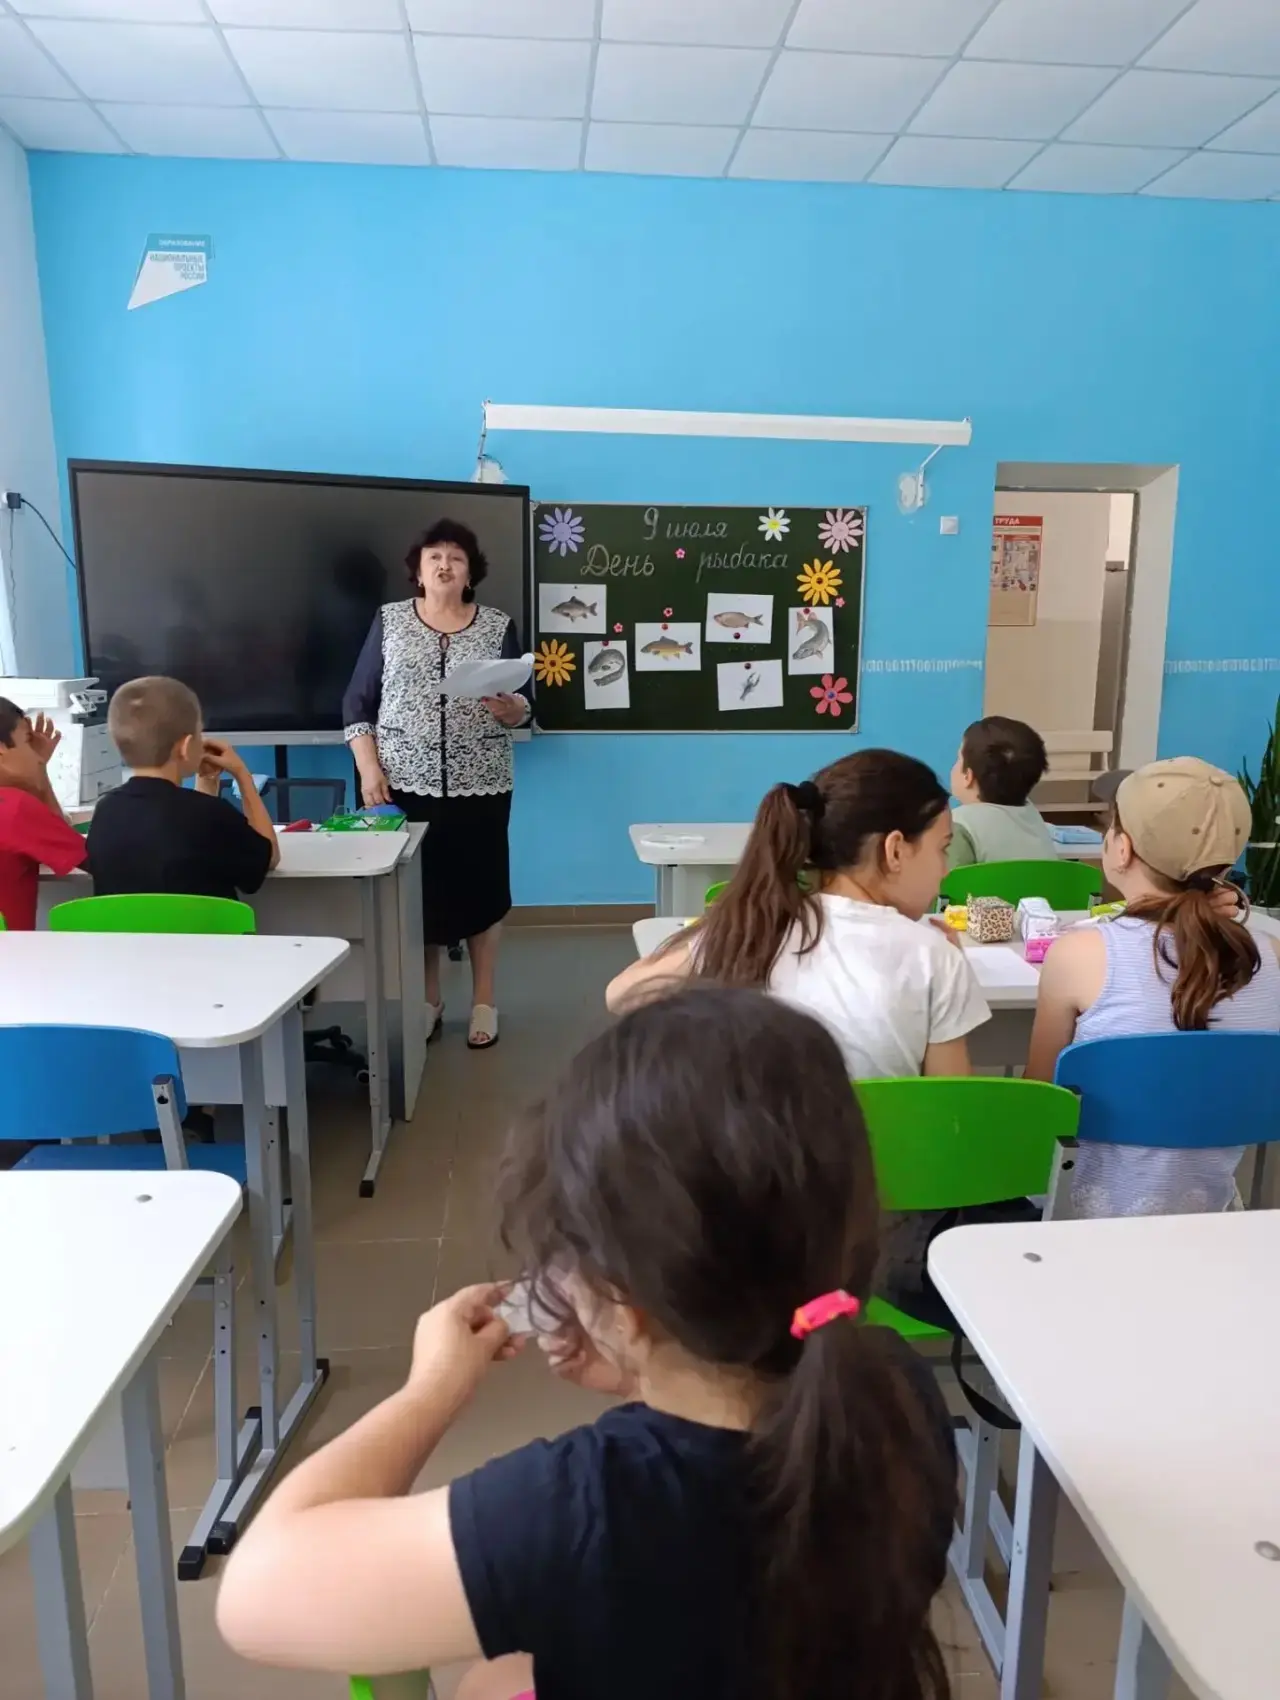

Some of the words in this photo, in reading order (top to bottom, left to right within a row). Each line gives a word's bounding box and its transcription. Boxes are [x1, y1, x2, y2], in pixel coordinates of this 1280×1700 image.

[643, 506, 660, 540] 9
[666, 521, 728, 538] июля
[580, 543, 655, 577] День
[695, 541, 789, 583] рыбака
